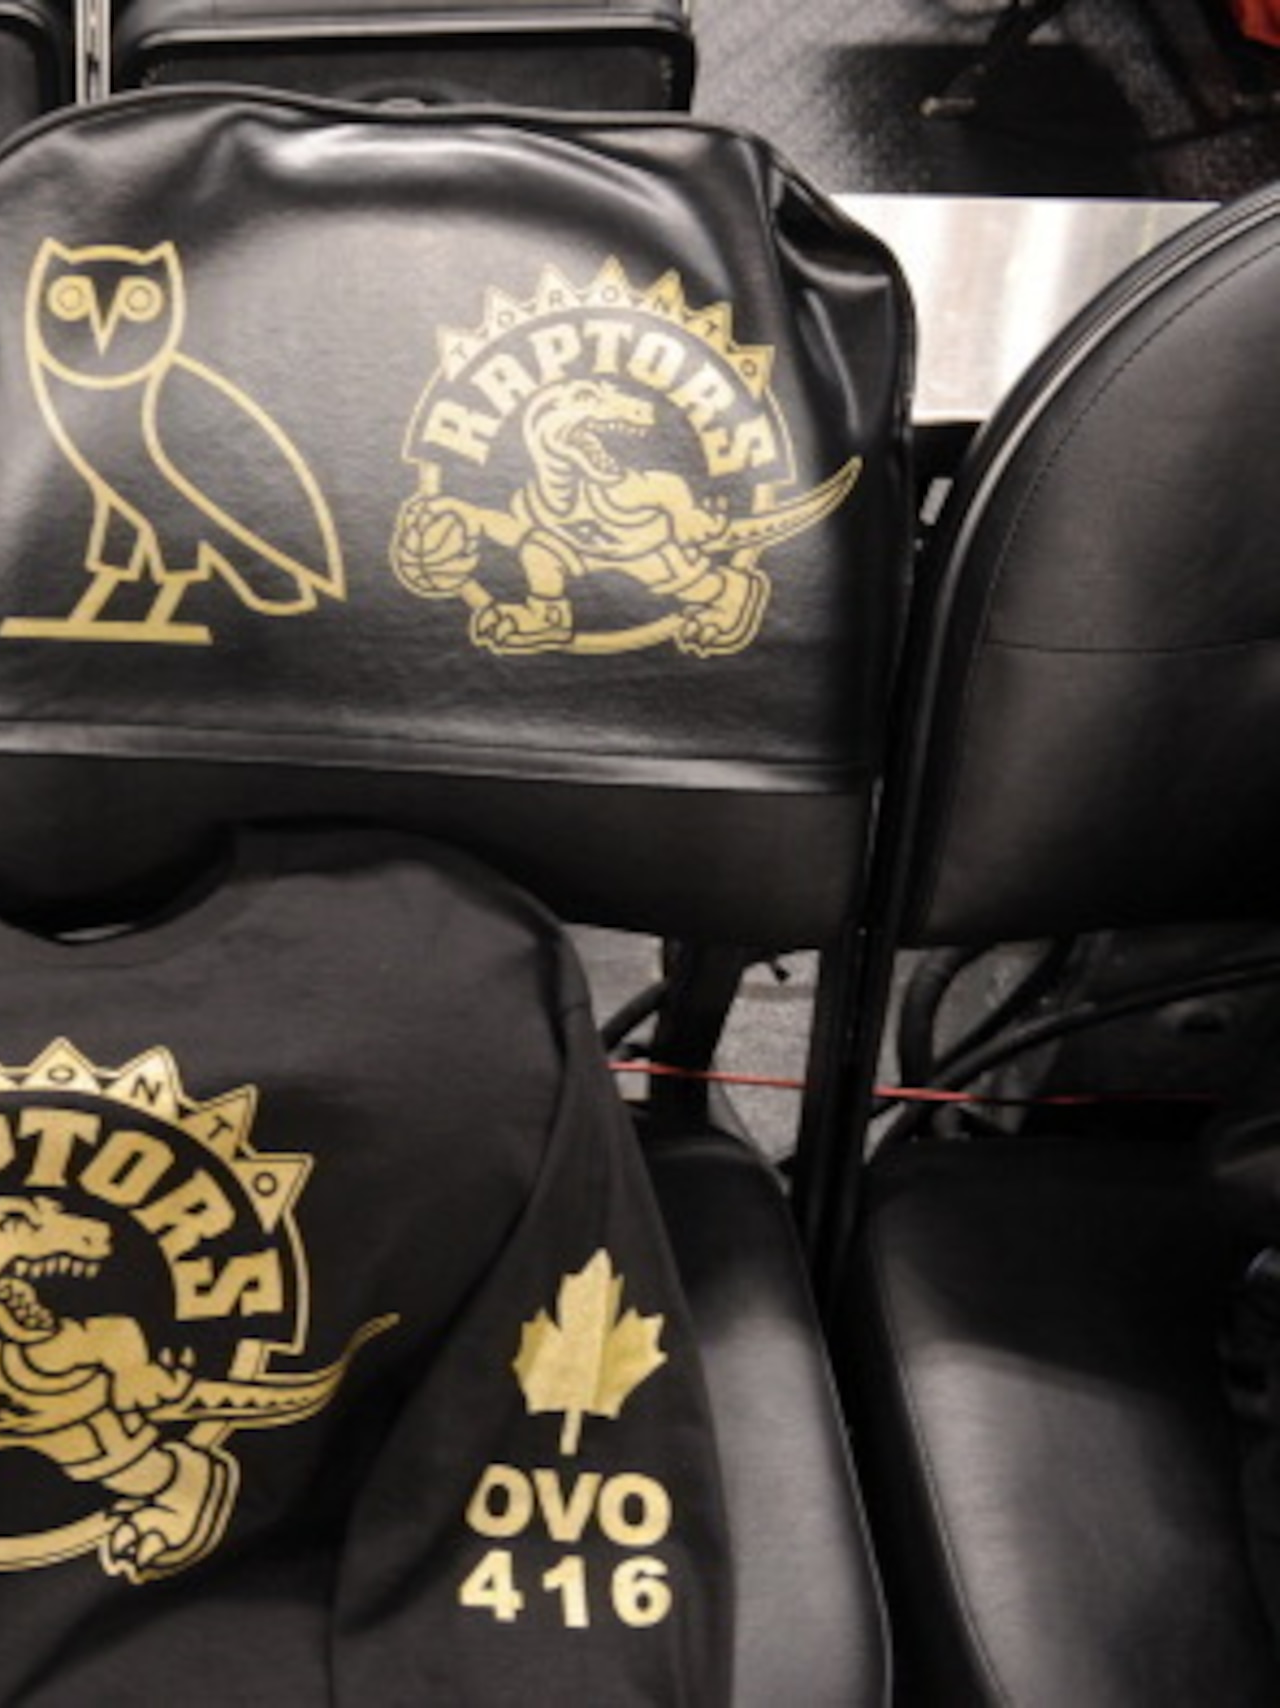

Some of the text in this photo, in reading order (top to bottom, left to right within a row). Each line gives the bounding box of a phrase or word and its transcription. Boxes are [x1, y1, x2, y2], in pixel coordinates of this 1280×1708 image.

[450, 283, 758, 378] TORONTO
[423, 319, 778, 478] RAPTORS
[465, 1463, 672, 1547] OVO
[458, 1549, 672, 1629] 416
